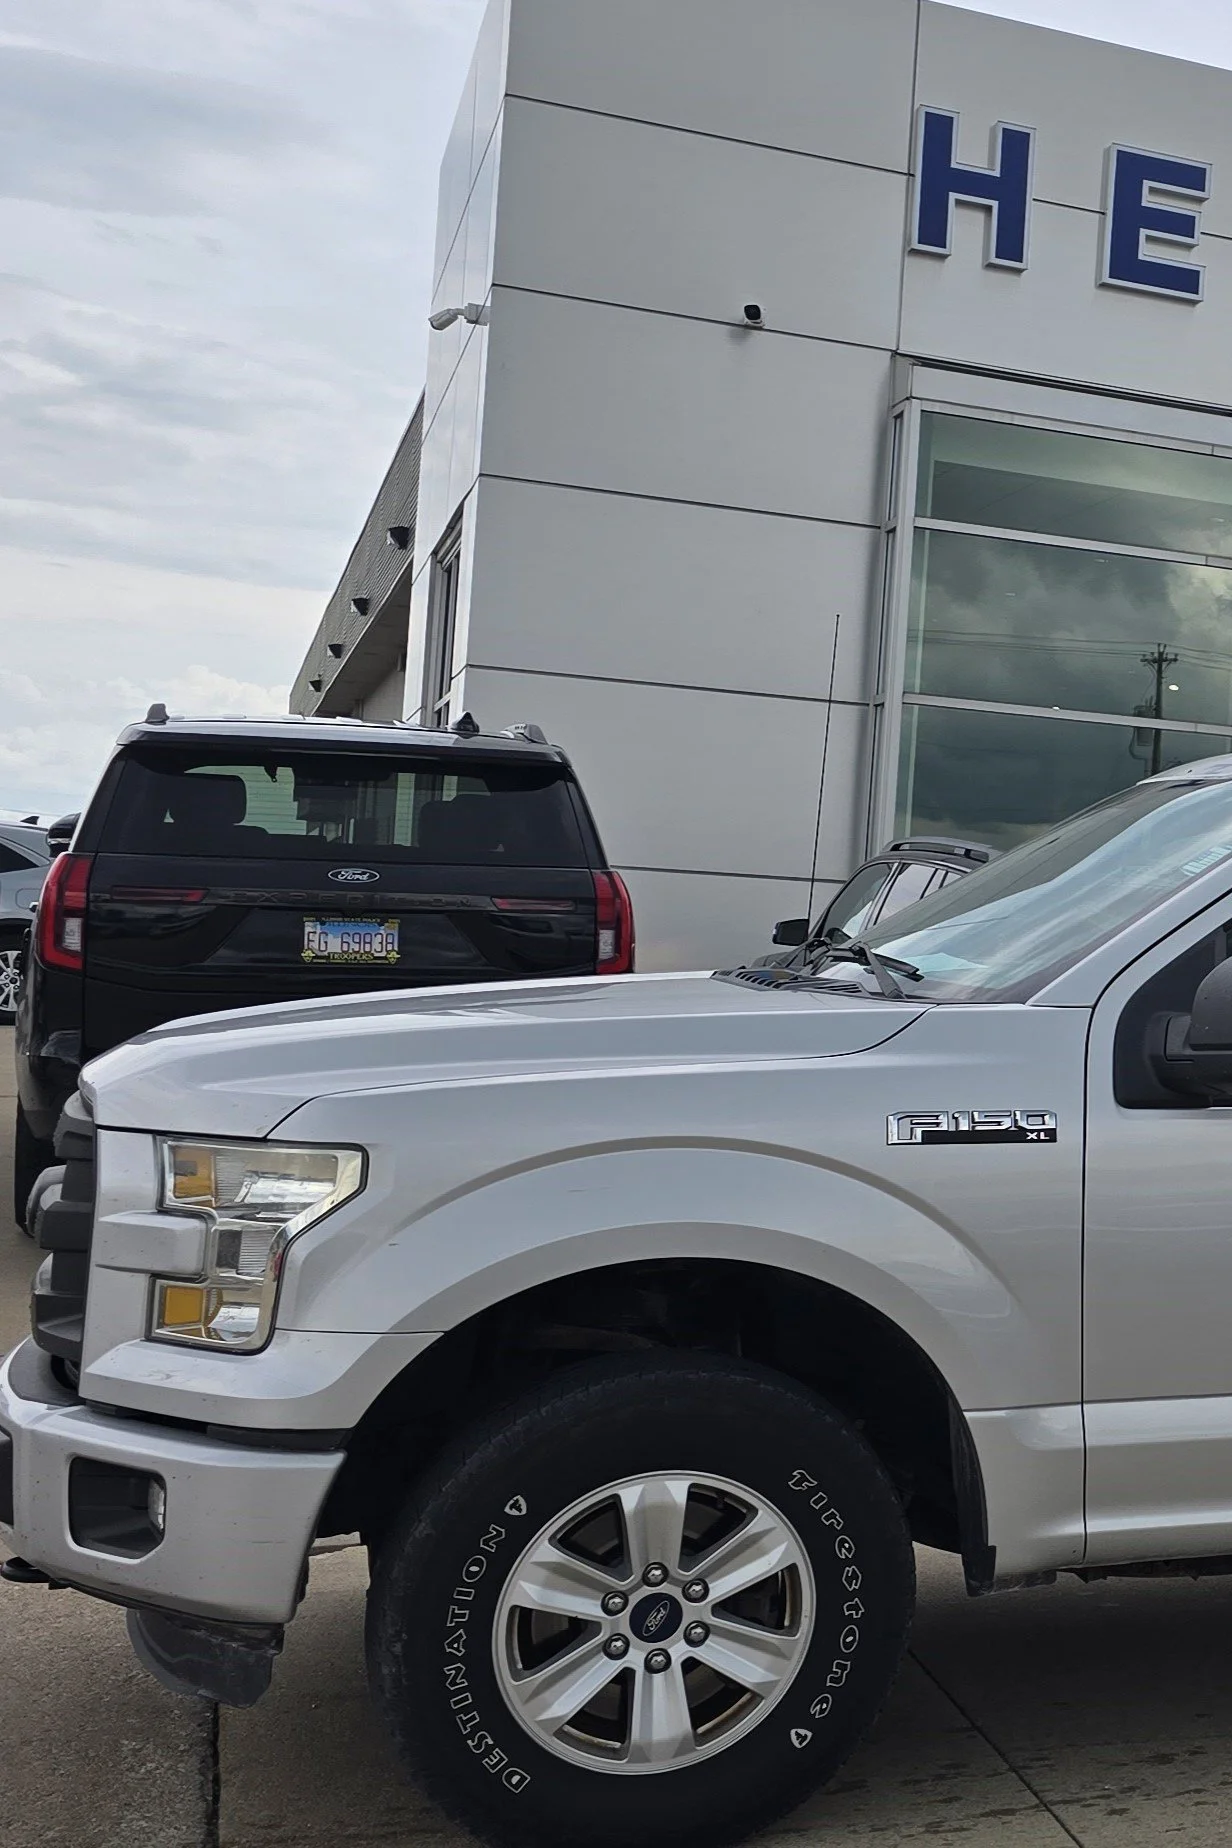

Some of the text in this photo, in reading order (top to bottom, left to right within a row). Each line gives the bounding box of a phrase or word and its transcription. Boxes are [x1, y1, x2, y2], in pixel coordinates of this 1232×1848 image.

[341, 931, 395, 954] 69838
[329, 952, 374, 960] TROOPERS
[1025, 1131, 1050, 1140] XL
[787, 1470, 865, 1719] Firestone
[444, 1524, 531, 1793] DESTINATION
